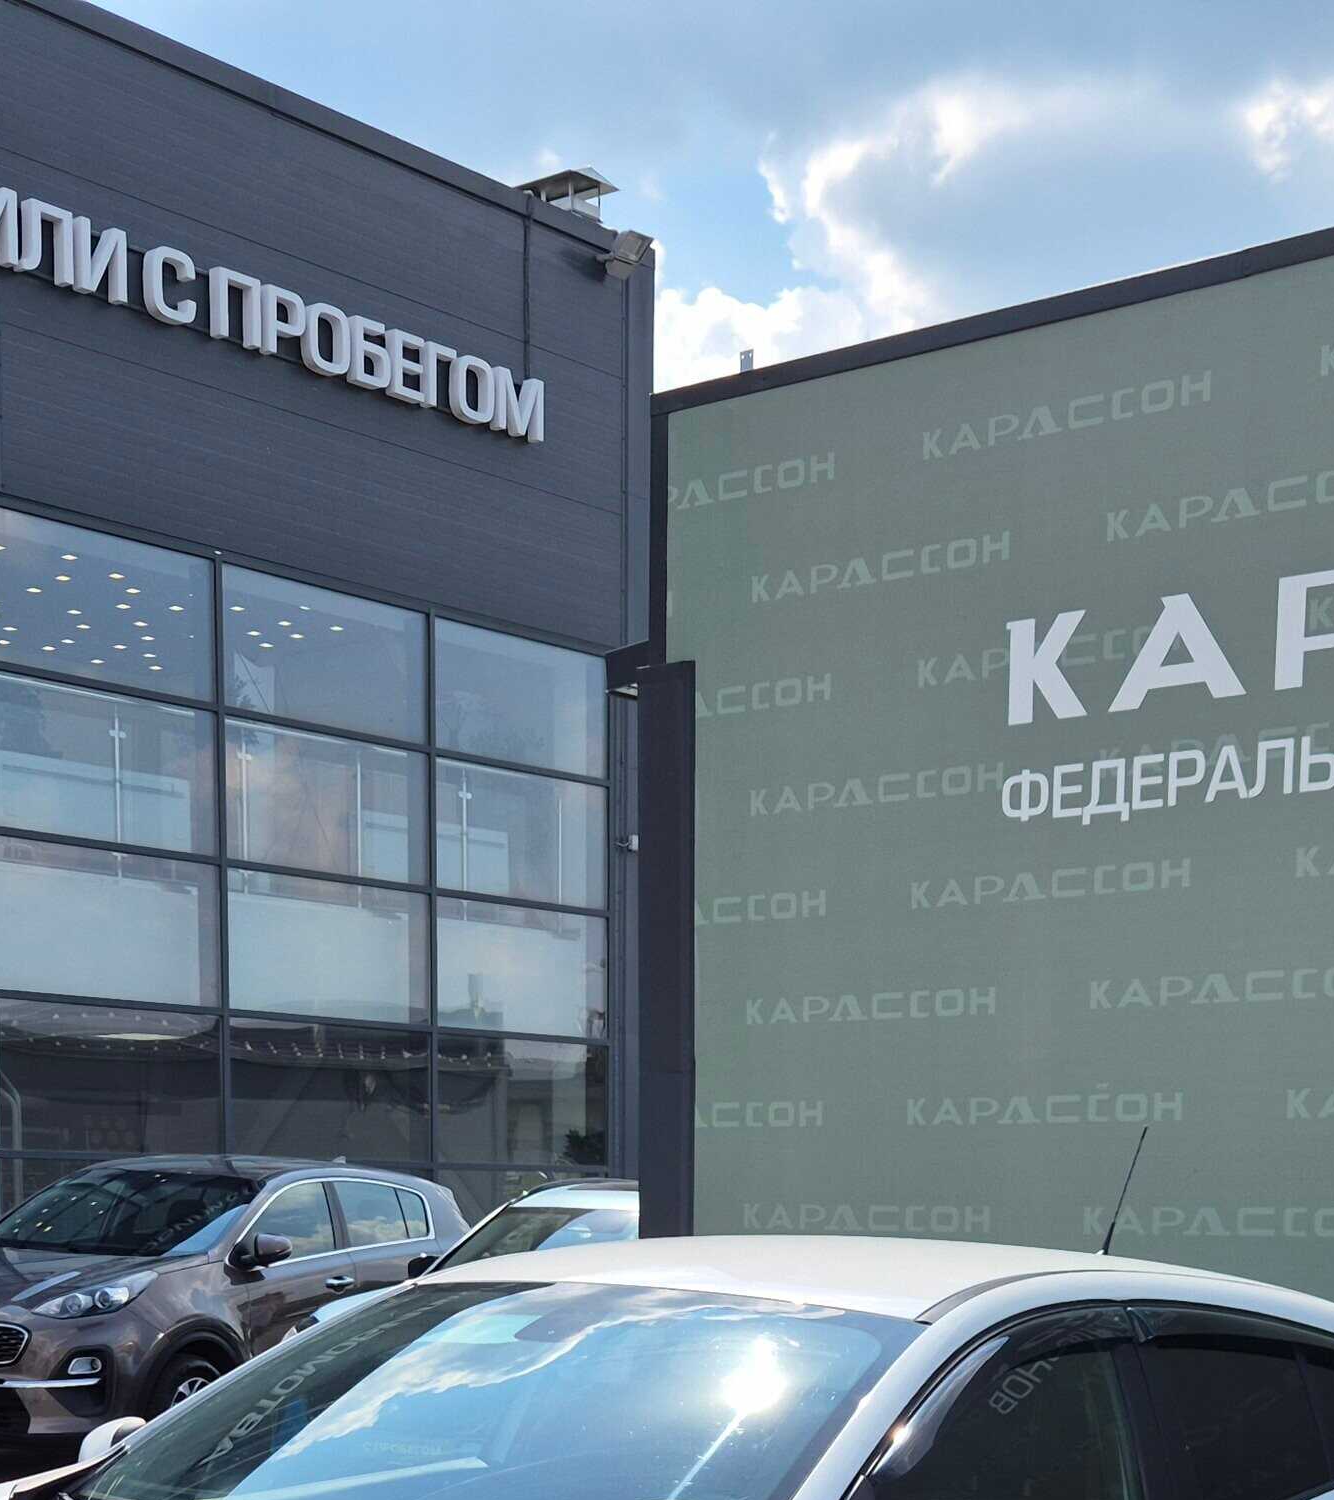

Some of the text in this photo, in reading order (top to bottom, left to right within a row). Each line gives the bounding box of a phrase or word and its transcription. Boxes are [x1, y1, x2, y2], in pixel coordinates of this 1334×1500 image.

[142, 245, 197, 325] С
[209, 266, 545, 443] ПРОБЕГОМ
[922, 370, 1212, 461] КАРАССОН
[751, 531, 1010, 604] КАРАССОН
[911, 858, 1191, 910] КАРАССОН
[746, 987, 996, 1025] КАРАССОН
[907, 1092, 1183, 1126] КАРАССОН
